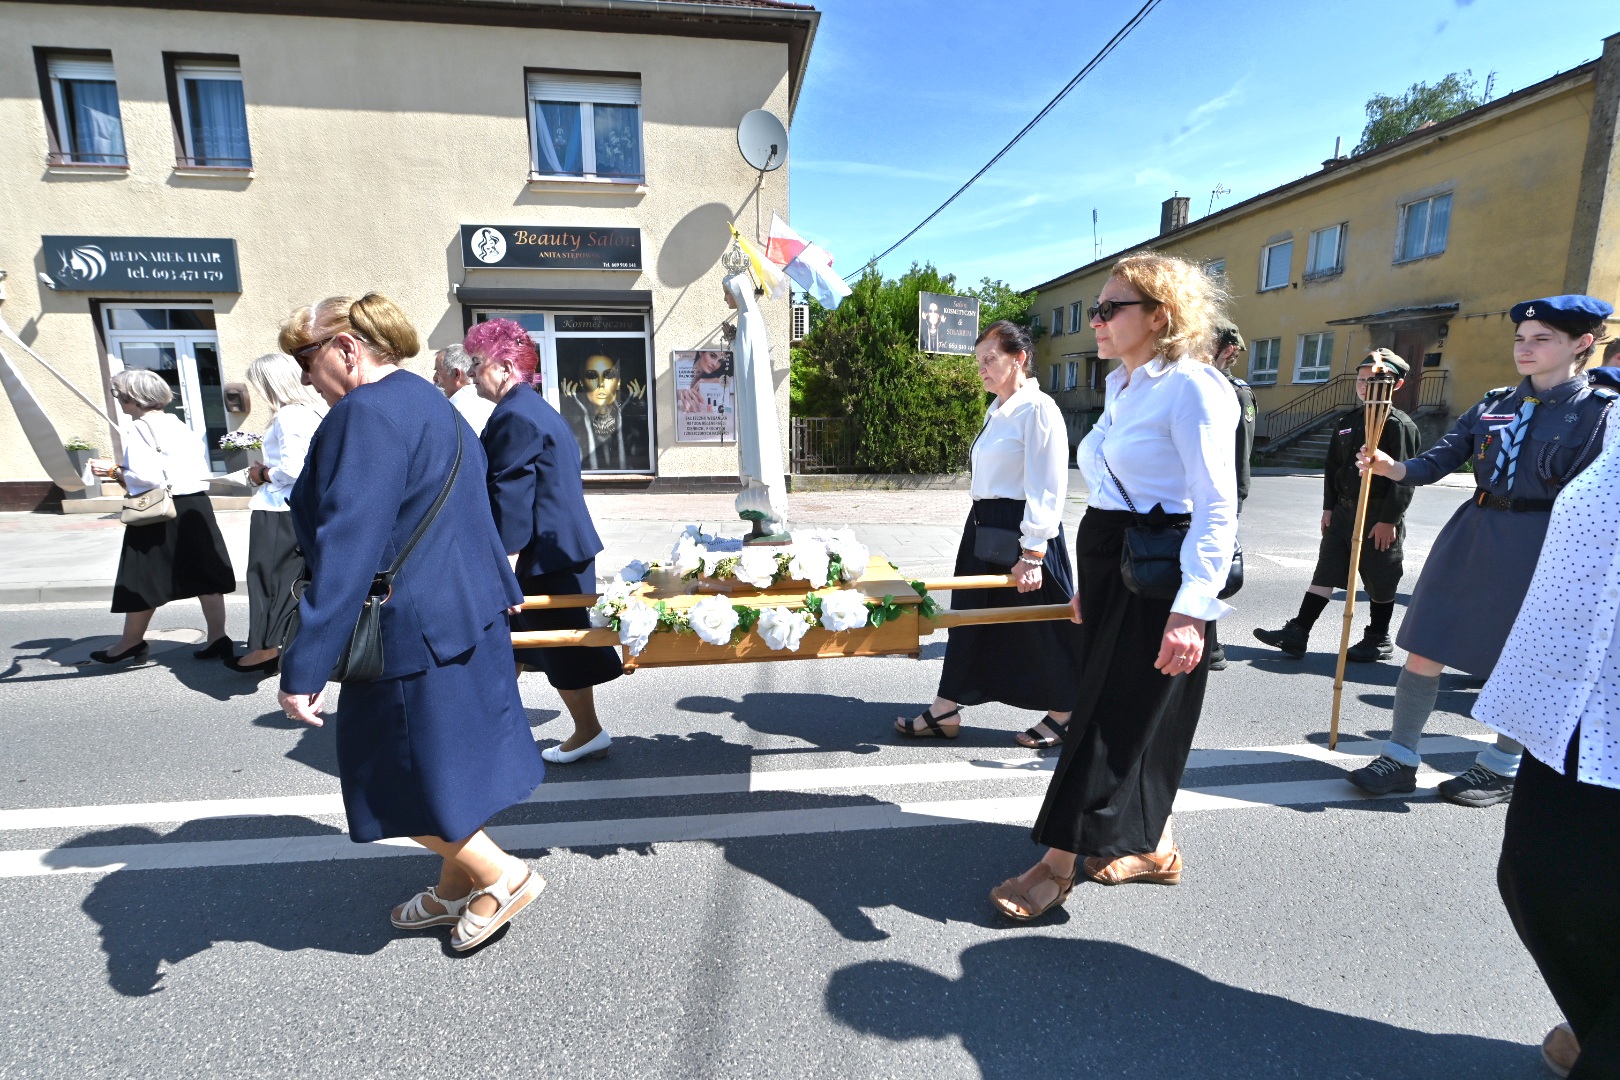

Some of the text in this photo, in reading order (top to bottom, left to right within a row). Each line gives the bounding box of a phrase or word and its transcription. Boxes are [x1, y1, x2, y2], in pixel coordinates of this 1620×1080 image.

[513, 230, 636, 251] Beauty Salon
[109, 250, 222, 263] BEDNAREK HAIR
[539, 251, 561, 259] ANITA
[127, 266, 223, 281] tel. 693 471 179
[562, 319, 633, 330] Kosmetyczny
[1437, 339, 1444, 349] 2
